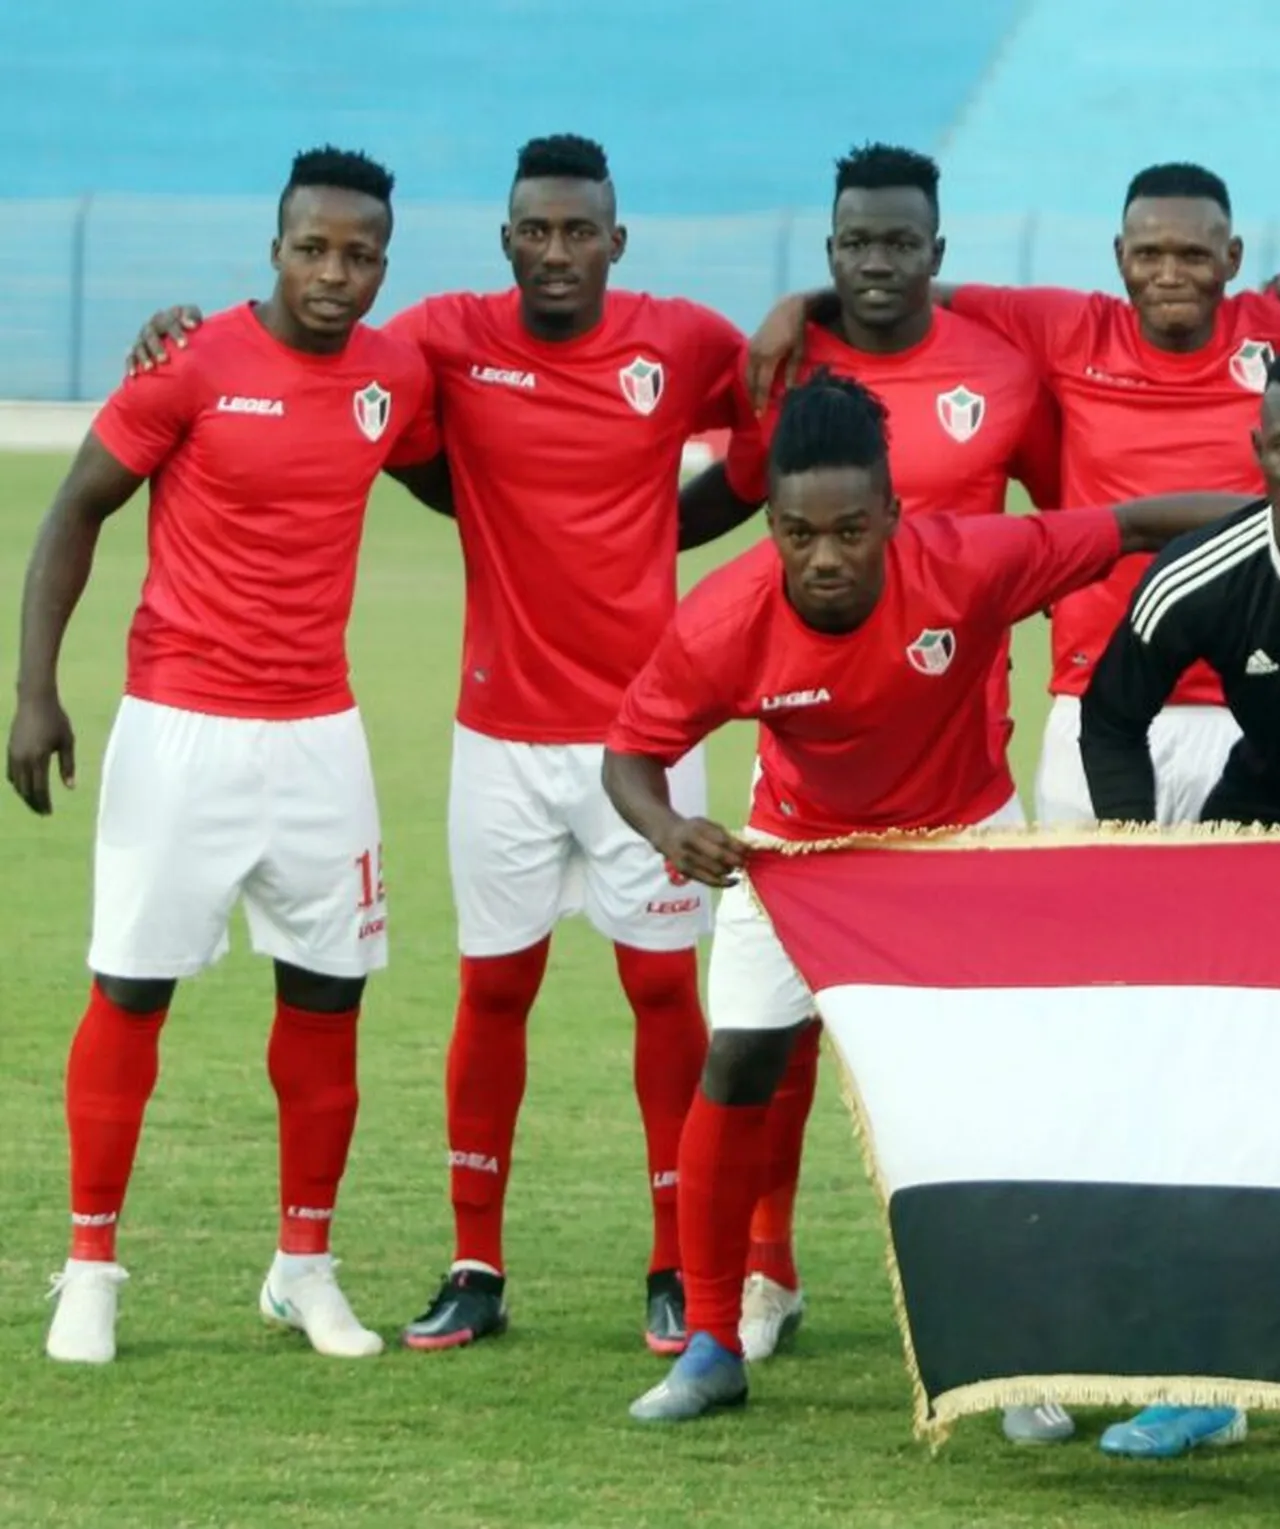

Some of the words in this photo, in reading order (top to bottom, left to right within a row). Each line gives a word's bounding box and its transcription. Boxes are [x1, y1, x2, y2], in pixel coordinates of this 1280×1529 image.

[472, 365, 535, 389] LEGEA
[217, 396, 284, 417] LEGEA
[761, 688, 831, 711] LEGEA
